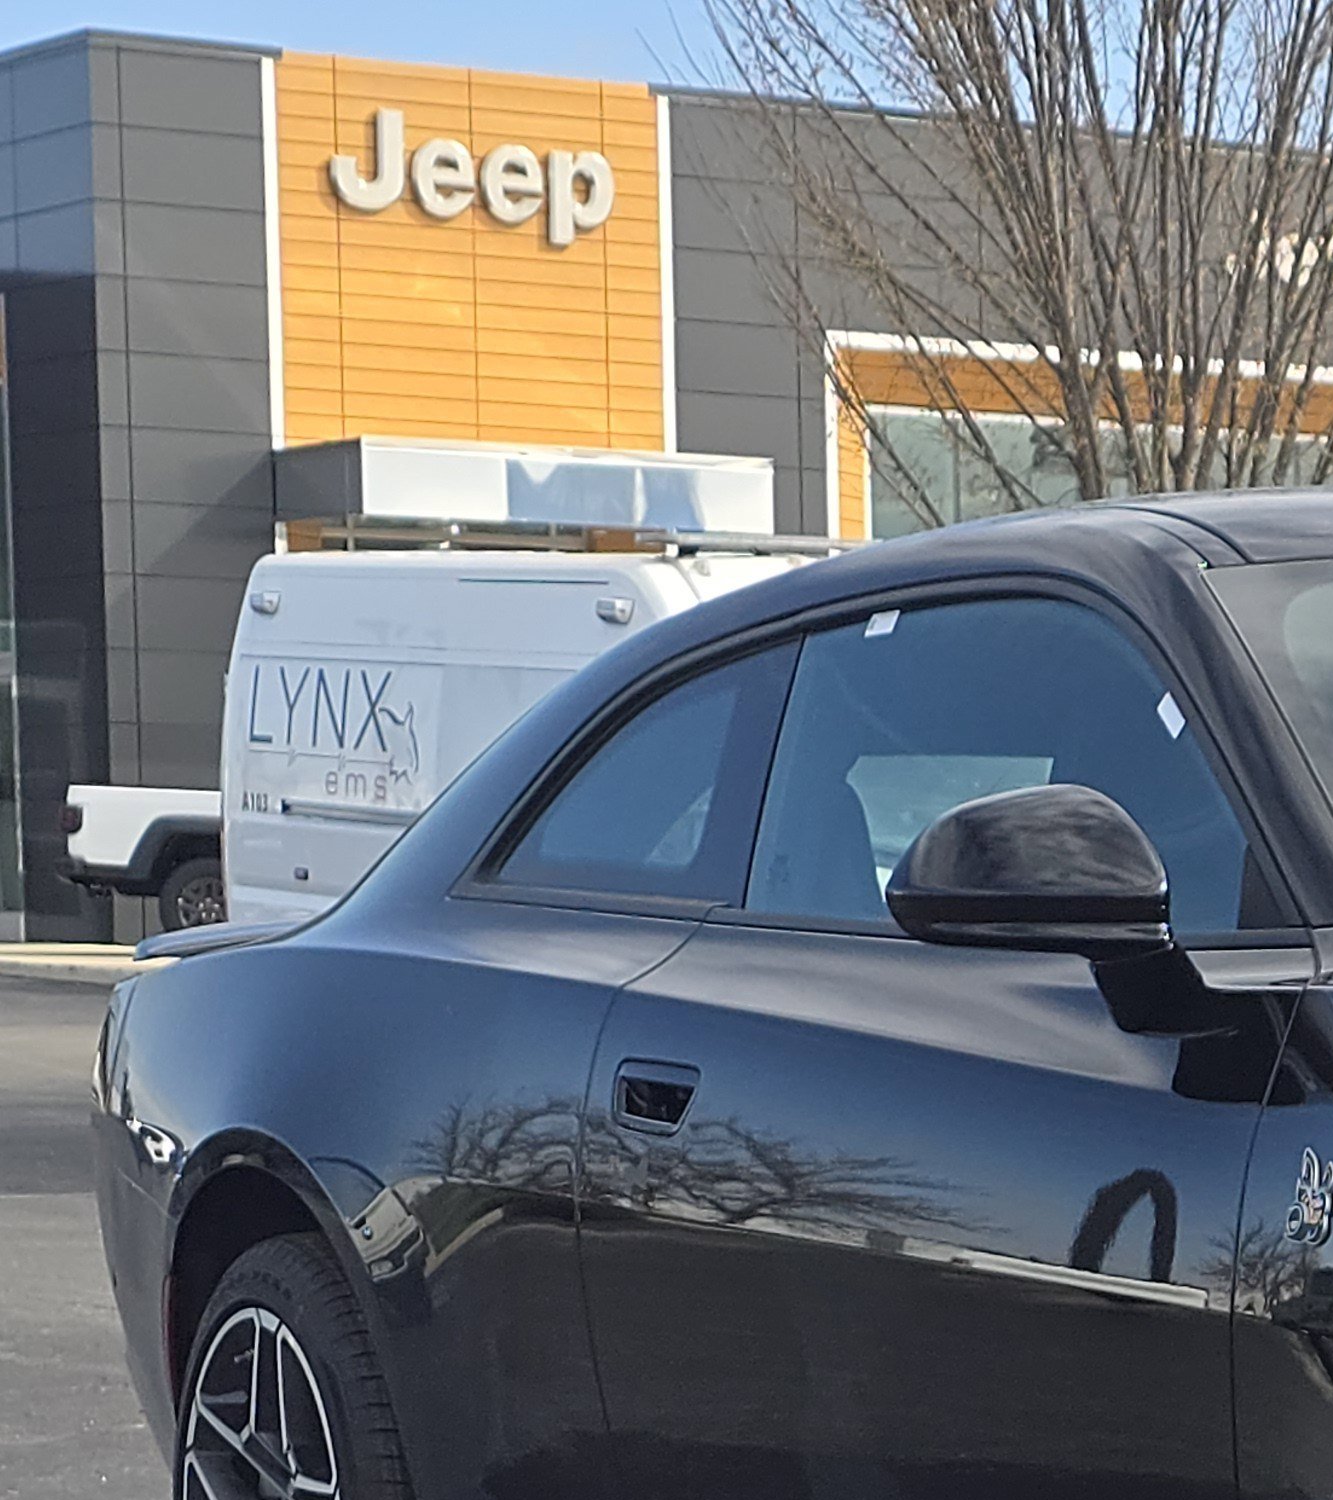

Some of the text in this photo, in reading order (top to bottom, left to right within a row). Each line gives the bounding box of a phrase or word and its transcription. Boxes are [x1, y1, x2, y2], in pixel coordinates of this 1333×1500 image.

[330, 107, 615, 246] Jeep
[250, 664, 392, 752] LYNX
[242, 791, 268, 812] A103
[325, 771, 387, 800] ems
